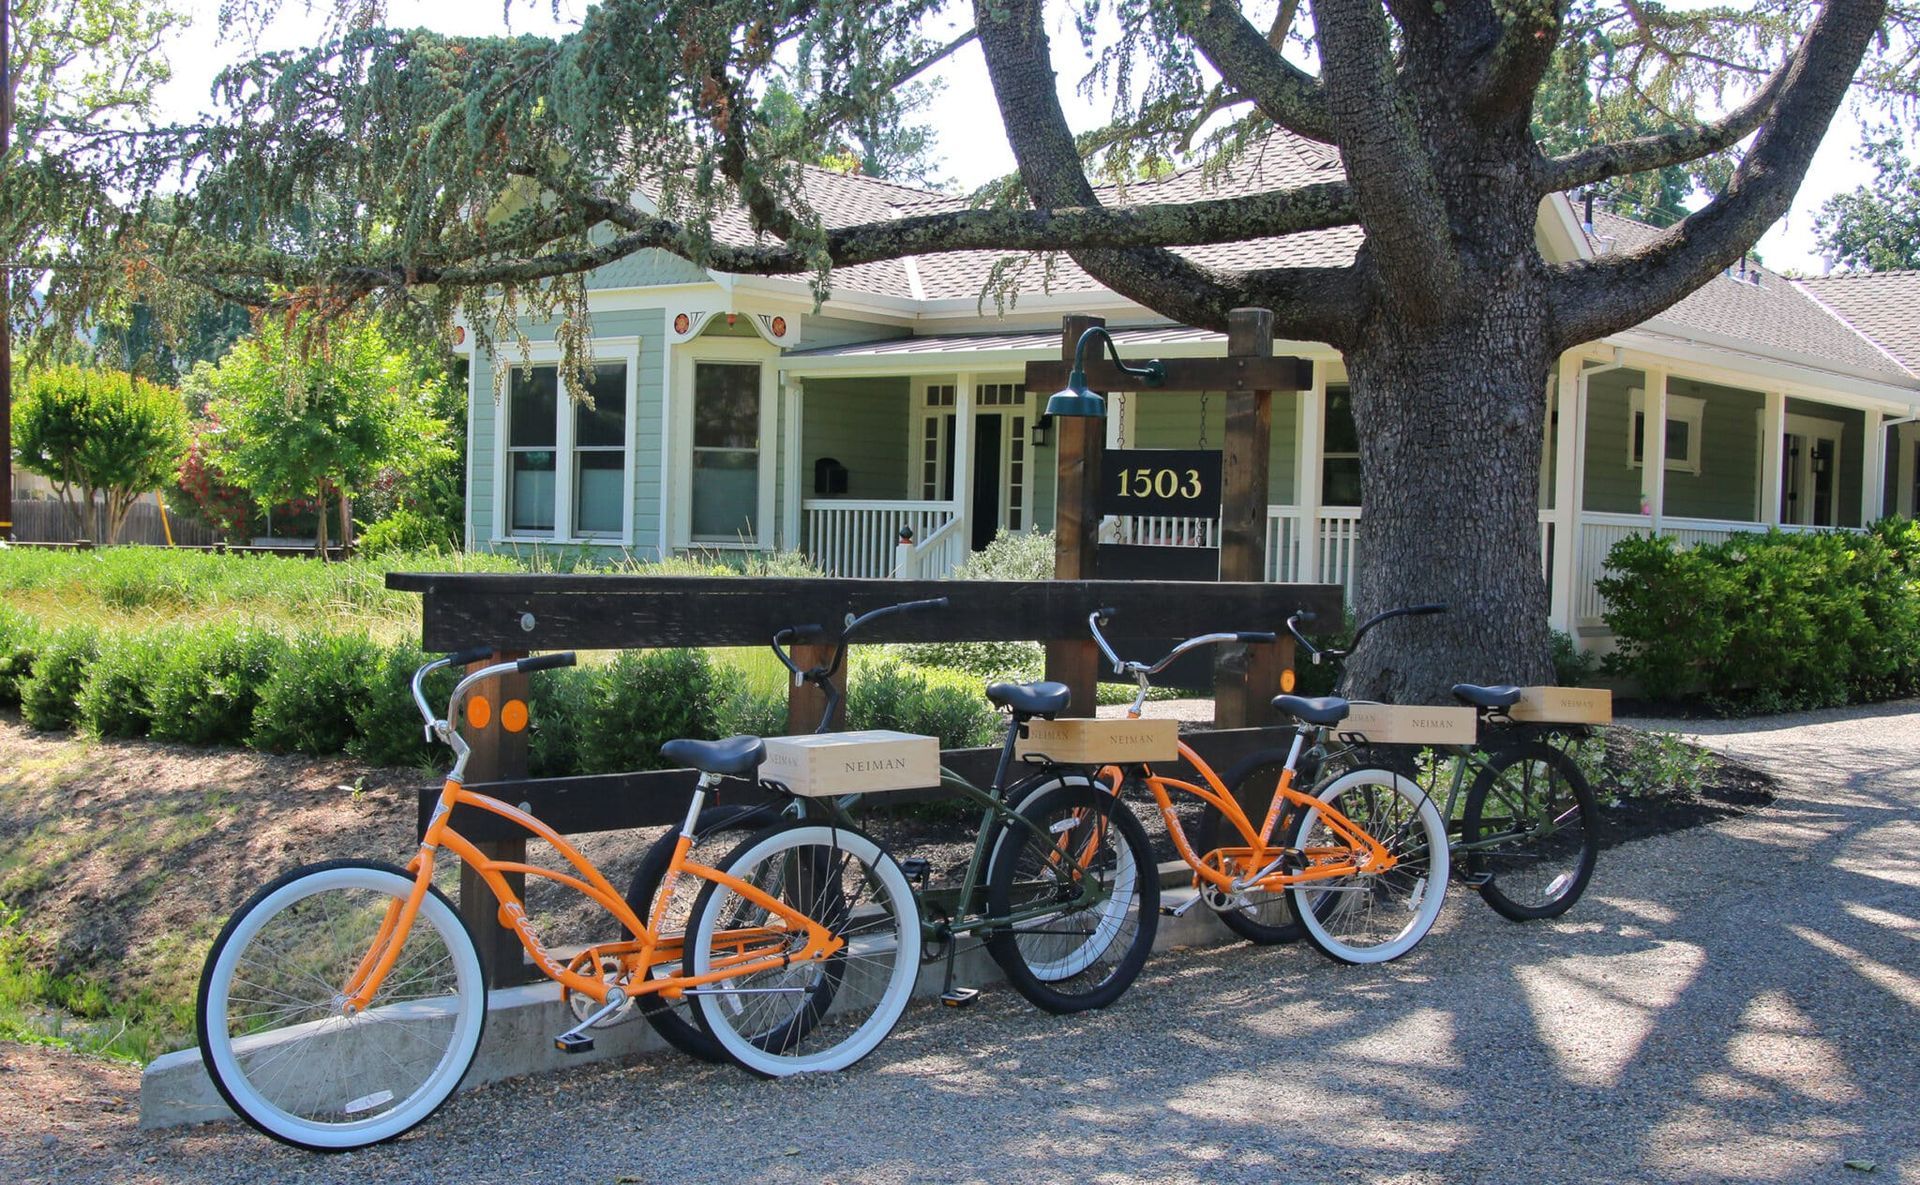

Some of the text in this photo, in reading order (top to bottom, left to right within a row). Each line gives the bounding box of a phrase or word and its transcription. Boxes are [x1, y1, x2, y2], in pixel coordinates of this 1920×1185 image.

[1117, 468, 1202, 498] 1503
[1560, 700, 1593, 709] NEIMAN
[1348, 713, 1376, 722] EIMAN
[1412, 719, 1455, 728] NEIMAN
[1110, 735, 1154, 745] NEIMAN
[845, 758, 906, 773] NEIMAN
